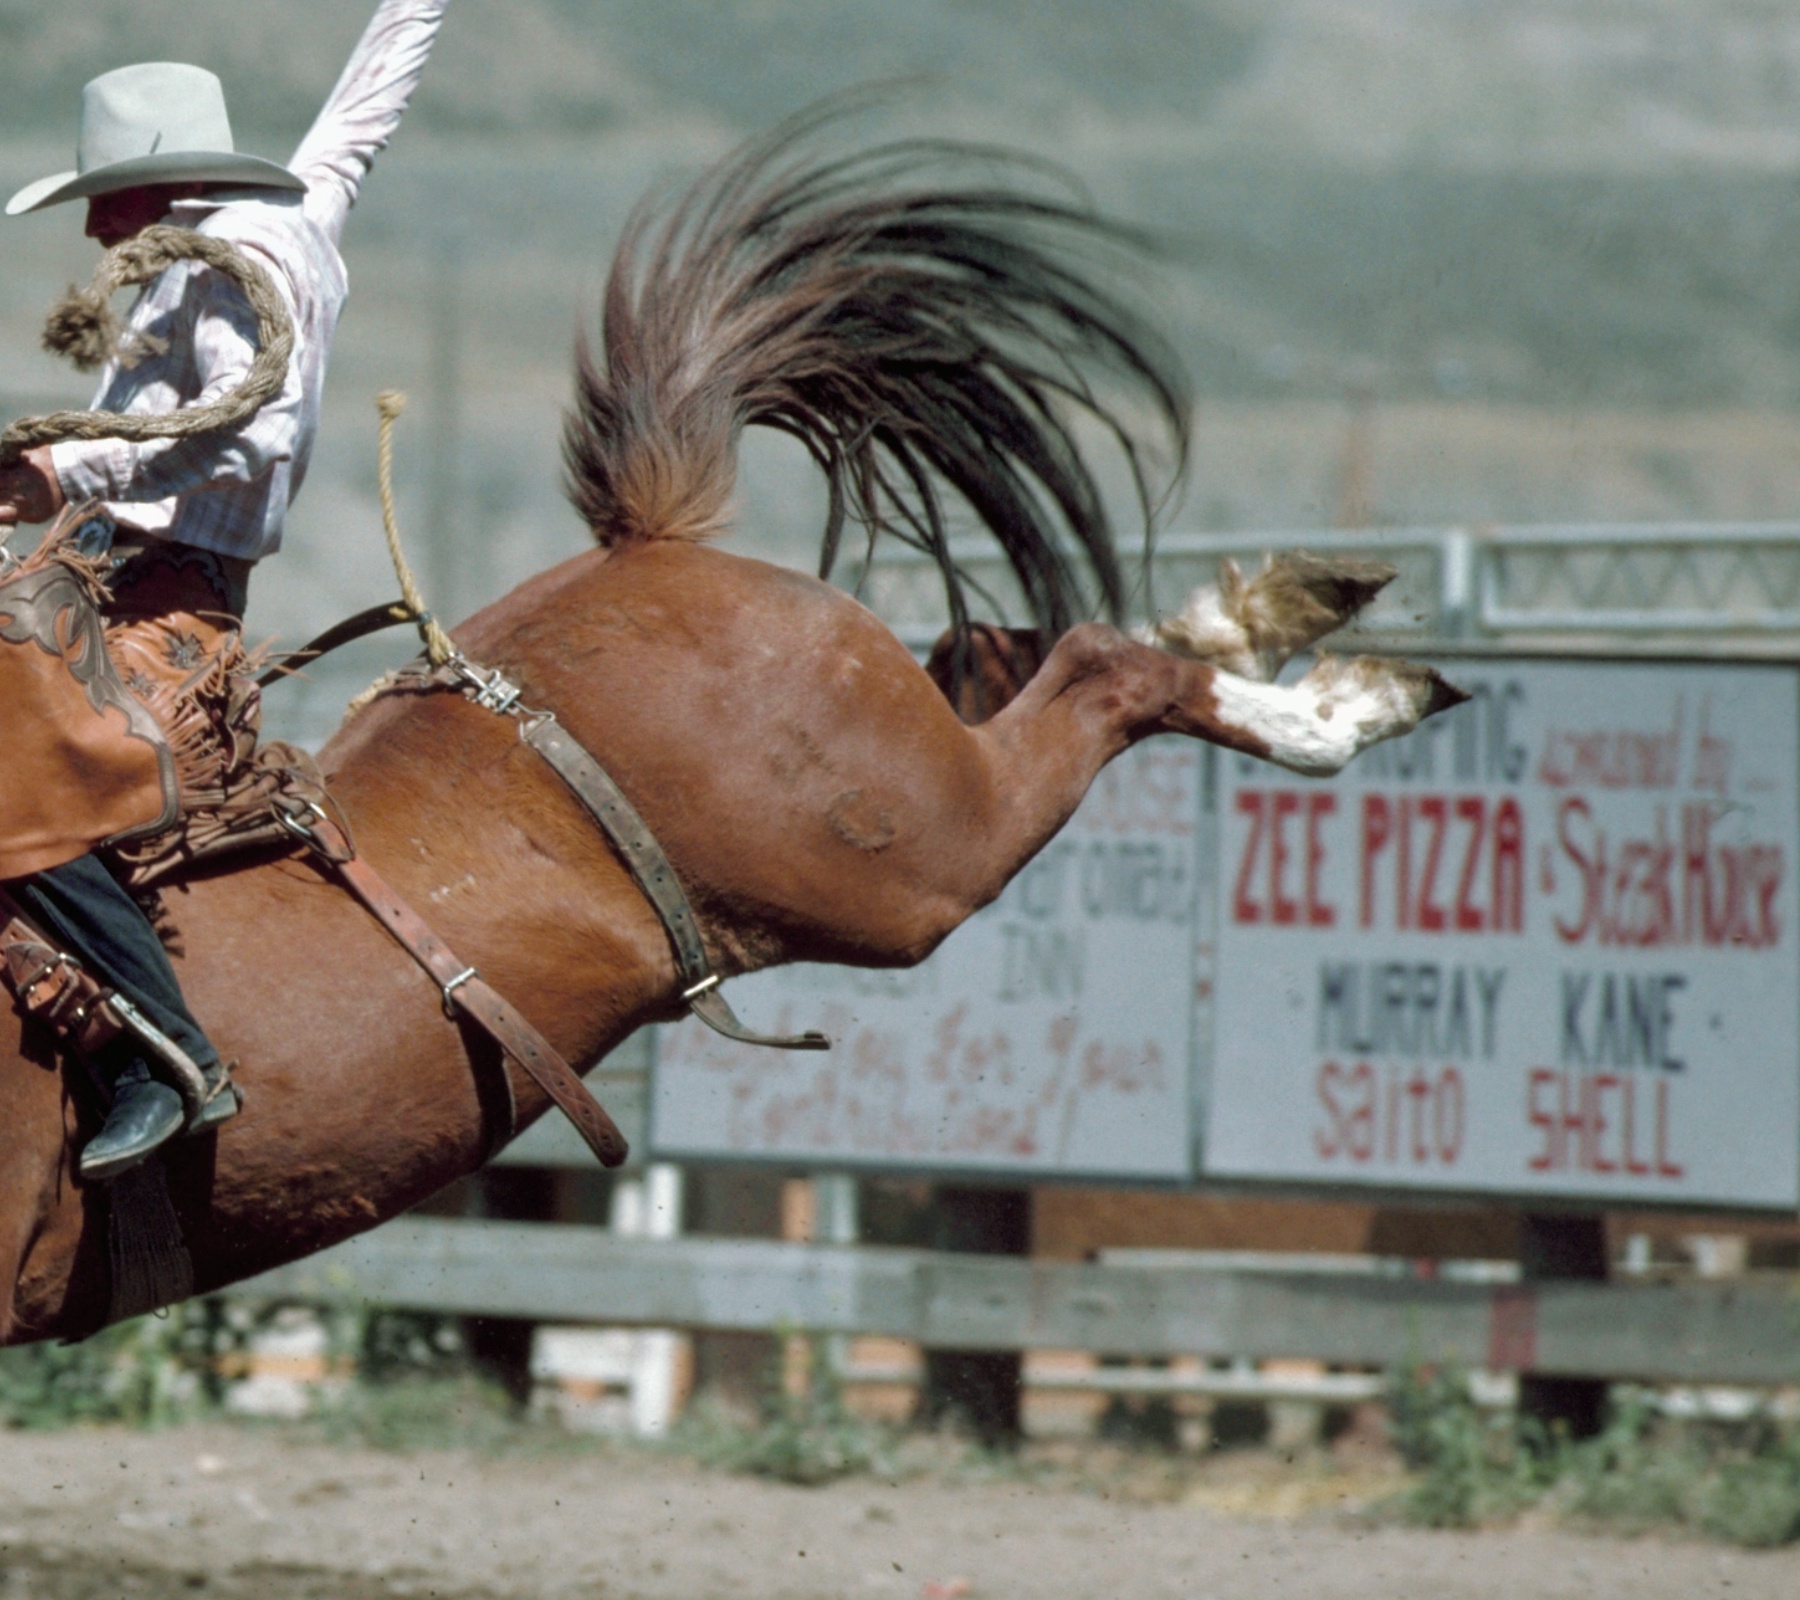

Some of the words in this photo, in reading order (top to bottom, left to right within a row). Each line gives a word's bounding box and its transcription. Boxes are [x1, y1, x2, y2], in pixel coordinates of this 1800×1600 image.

[1231, 791, 1338, 927] ZEE
[1357, 793, 1527, 935] PIZZA
[1315, 960, 1505, 1062] MURRAY
[1558, 968, 1688, 1074] KANE
[1528, 1066, 1686, 1180] SHELL
